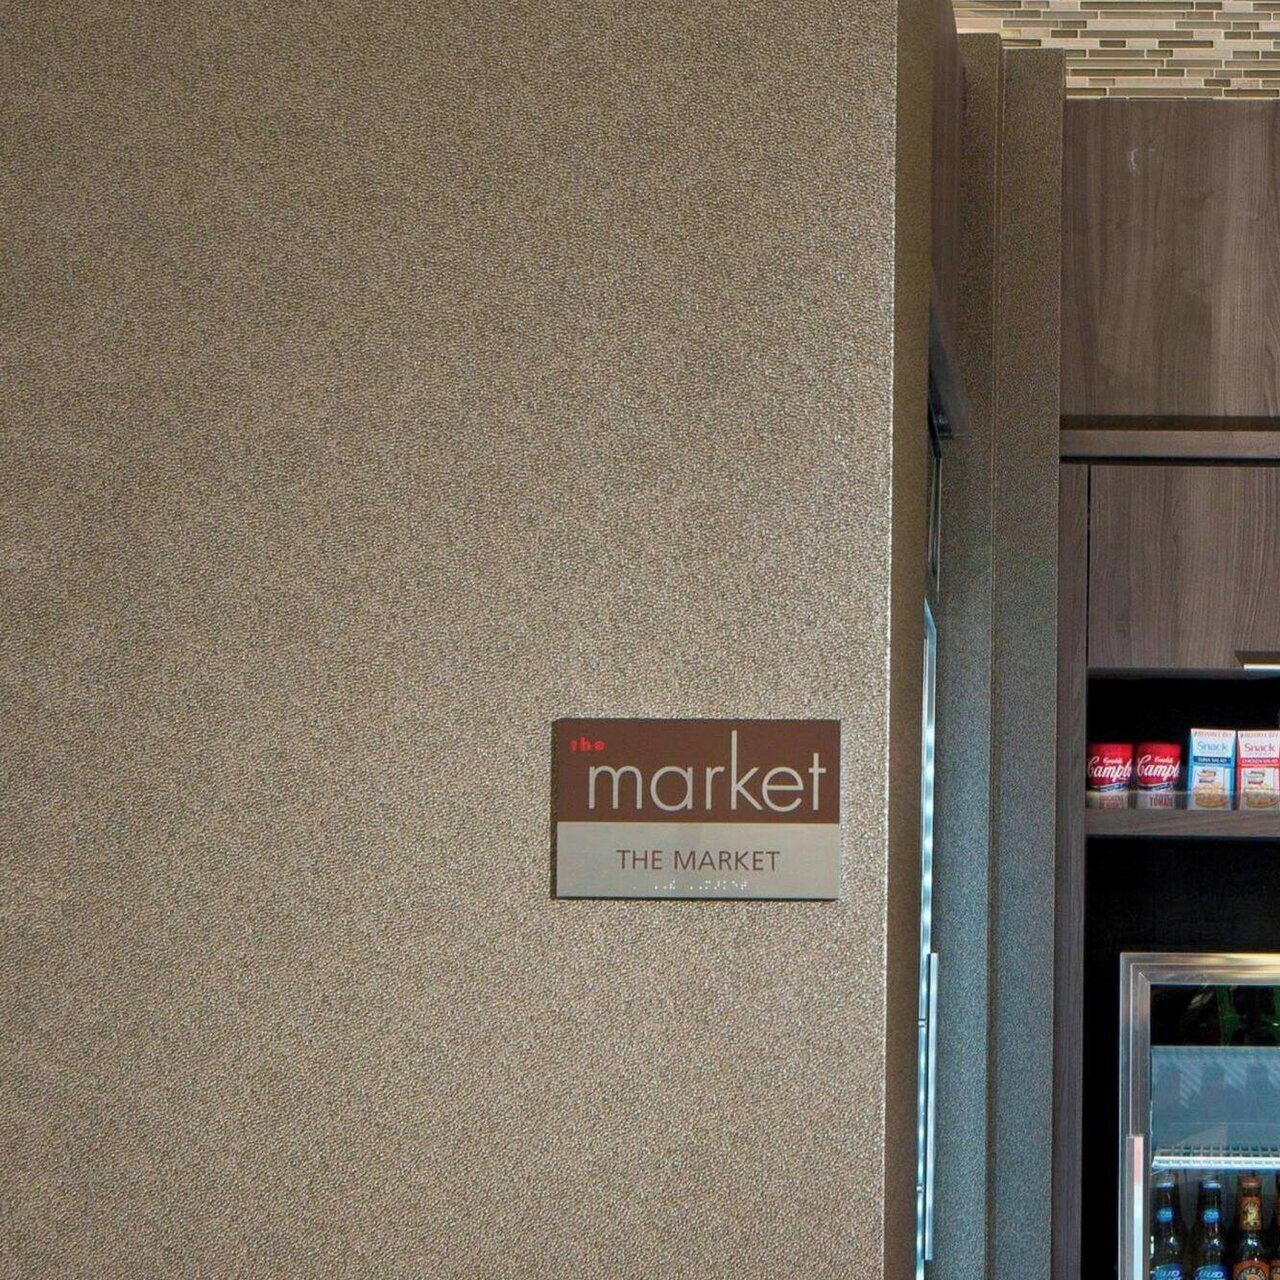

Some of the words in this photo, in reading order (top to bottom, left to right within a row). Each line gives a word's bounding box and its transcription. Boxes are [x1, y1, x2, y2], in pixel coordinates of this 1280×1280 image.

[569, 737, 605, 752] the
[1197, 741, 1226, 751] Snack
[1244, 743, 1276, 752] Snack
[588, 730, 827, 812] market
[616, 850, 662, 870] THE
[674, 850, 780, 871] MARKET
